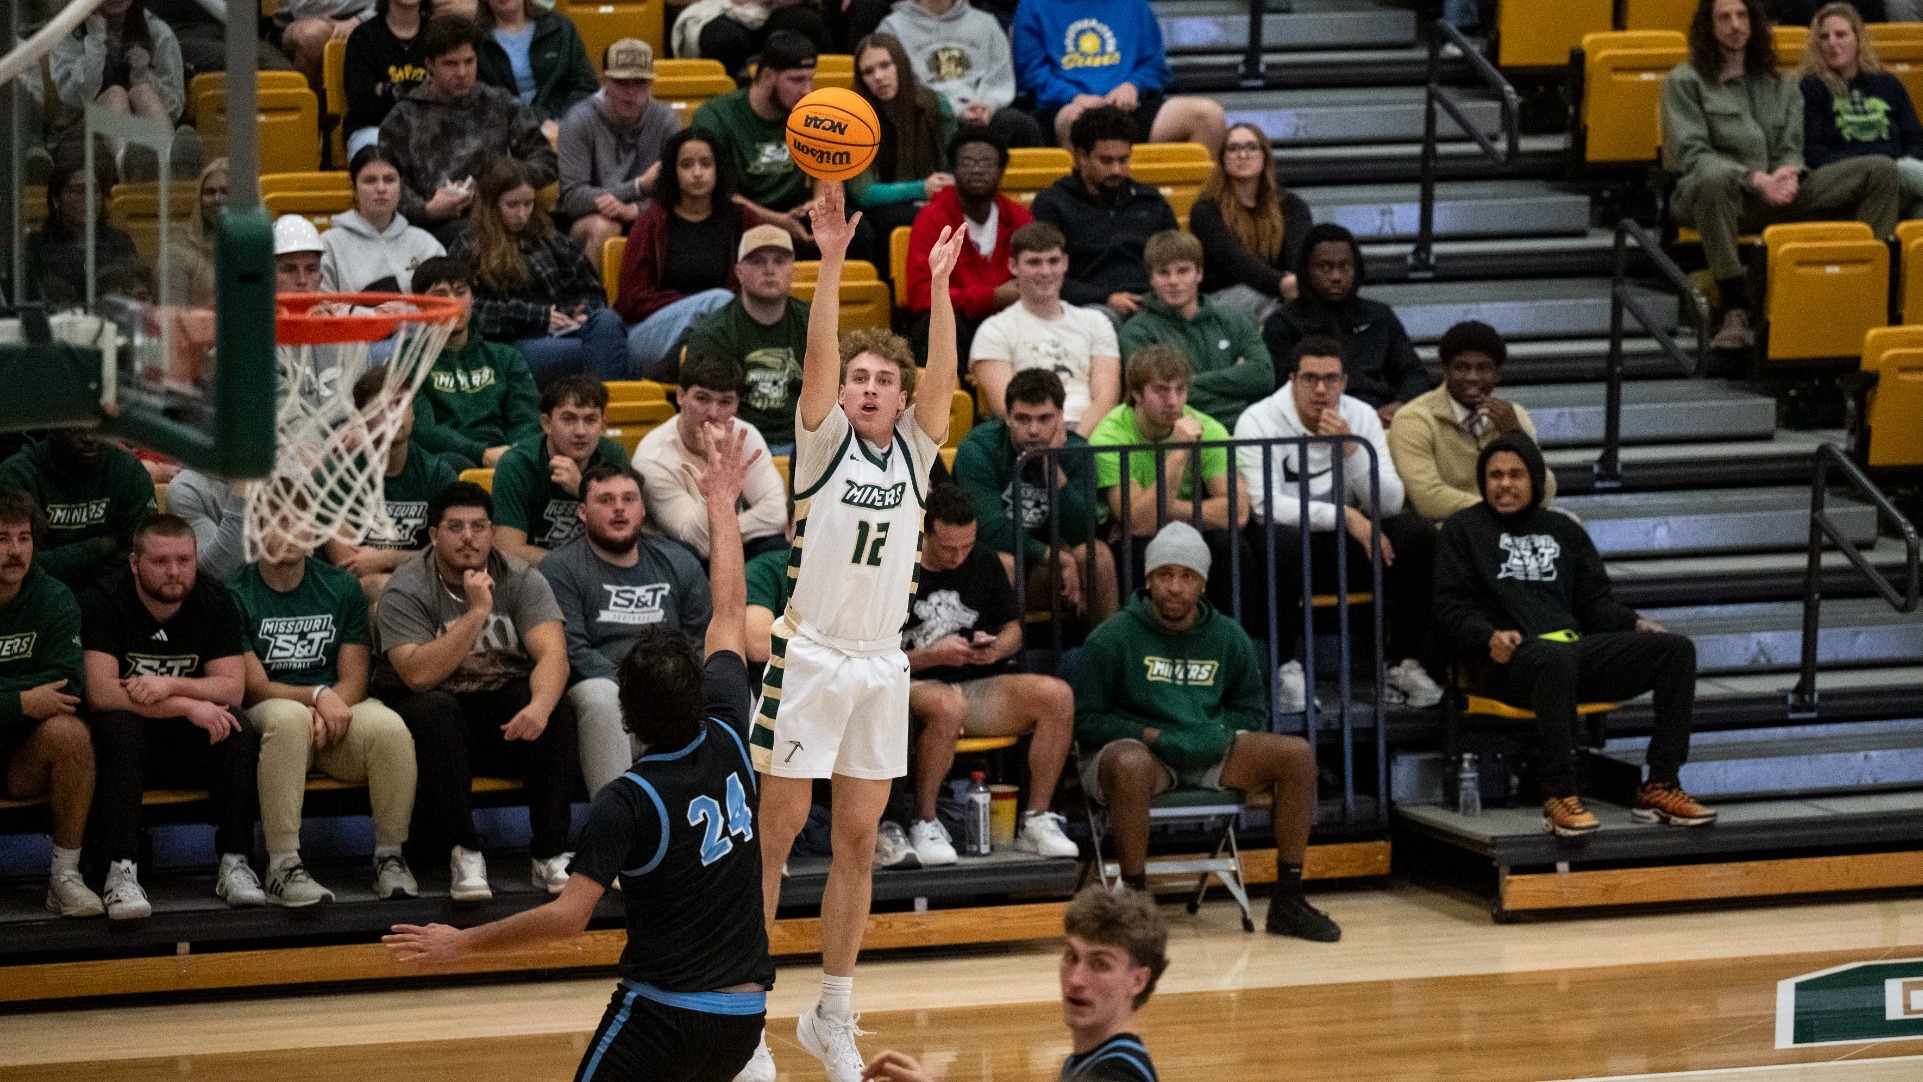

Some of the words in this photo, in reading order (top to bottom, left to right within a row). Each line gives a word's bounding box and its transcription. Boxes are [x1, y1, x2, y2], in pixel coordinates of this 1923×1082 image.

[804, 114, 849, 136] NCAA
[793, 138, 852, 166] Wilson
[845, 484, 903, 507] MINERS
[851, 520, 890, 567] 12
[612, 587, 666, 609] S&T
[263, 618, 328, 634] MISSOURI
[271, 631, 331, 658] S&T
[686, 771, 754, 868] 24
